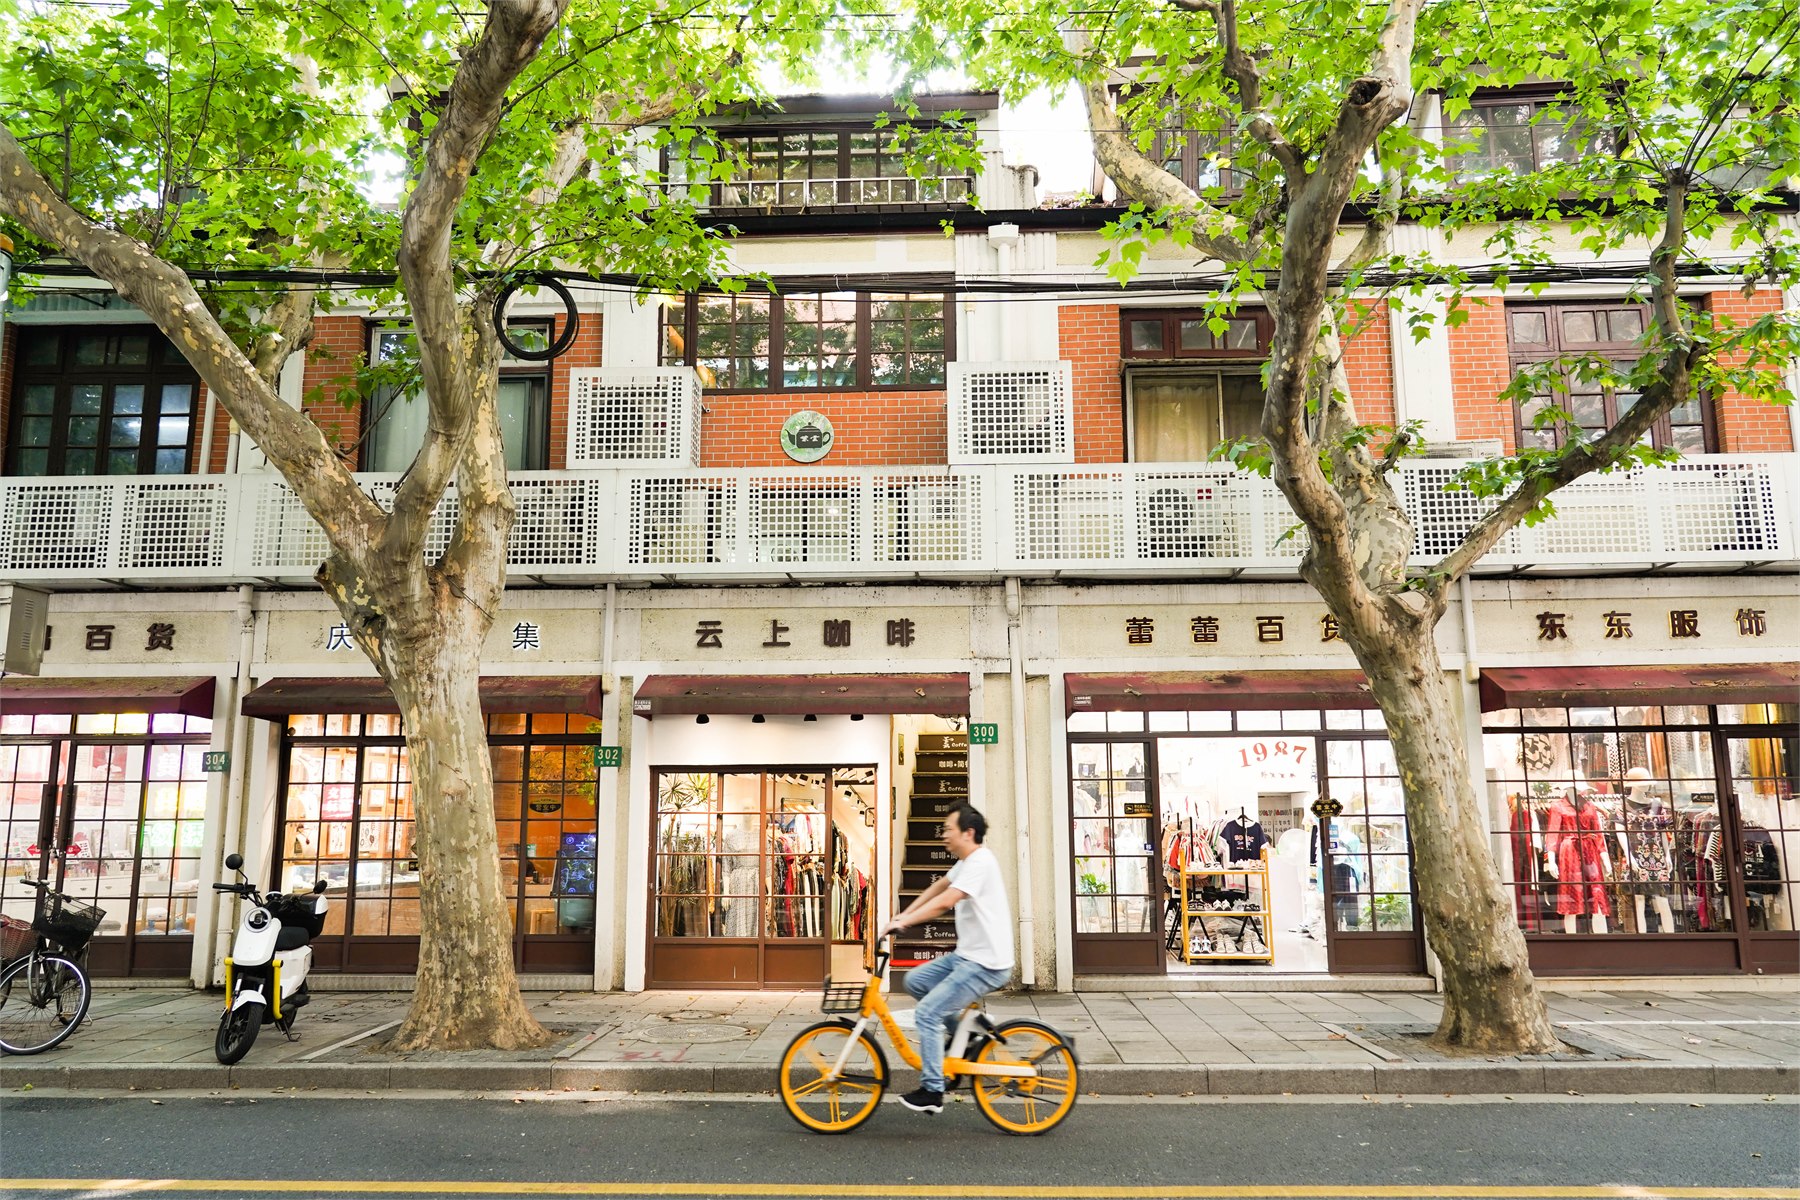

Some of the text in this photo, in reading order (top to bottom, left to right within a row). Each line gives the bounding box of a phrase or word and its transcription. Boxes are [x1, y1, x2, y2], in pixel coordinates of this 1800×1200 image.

[44, 623, 176, 651] 百货
[695, 618, 916, 648] 云上咖啡
[1535, 608, 1767, 640] 东东服饰
[973, 726, 994, 737] 300
[205, 754, 225, 766] 304
[597, 749, 618, 760] 302
[1238, 741, 1307, 767] 1987
